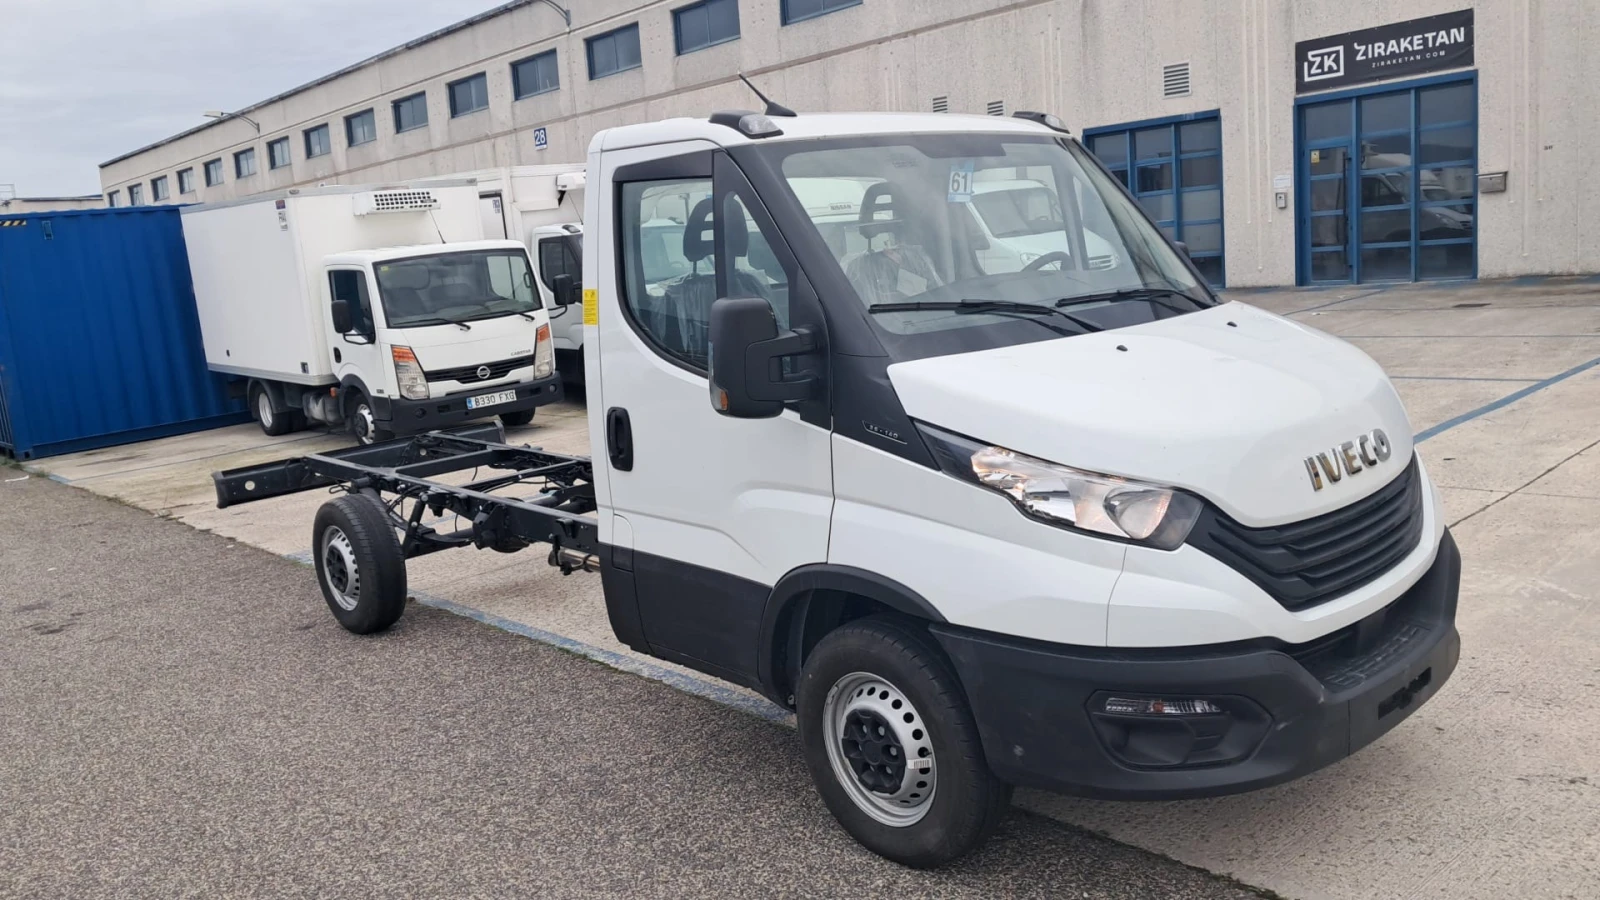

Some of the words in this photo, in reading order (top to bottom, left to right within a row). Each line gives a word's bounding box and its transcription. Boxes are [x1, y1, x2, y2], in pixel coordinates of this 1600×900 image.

[1354, 27, 1465, 61] ZIRAKETAN
[1372, 50, 1445, 68] ZIRAKETAN.COM
[534, 129, 546, 145] 28
[951, 171, 968, 193] 61
[1303, 428, 1392, 492] IVECO
